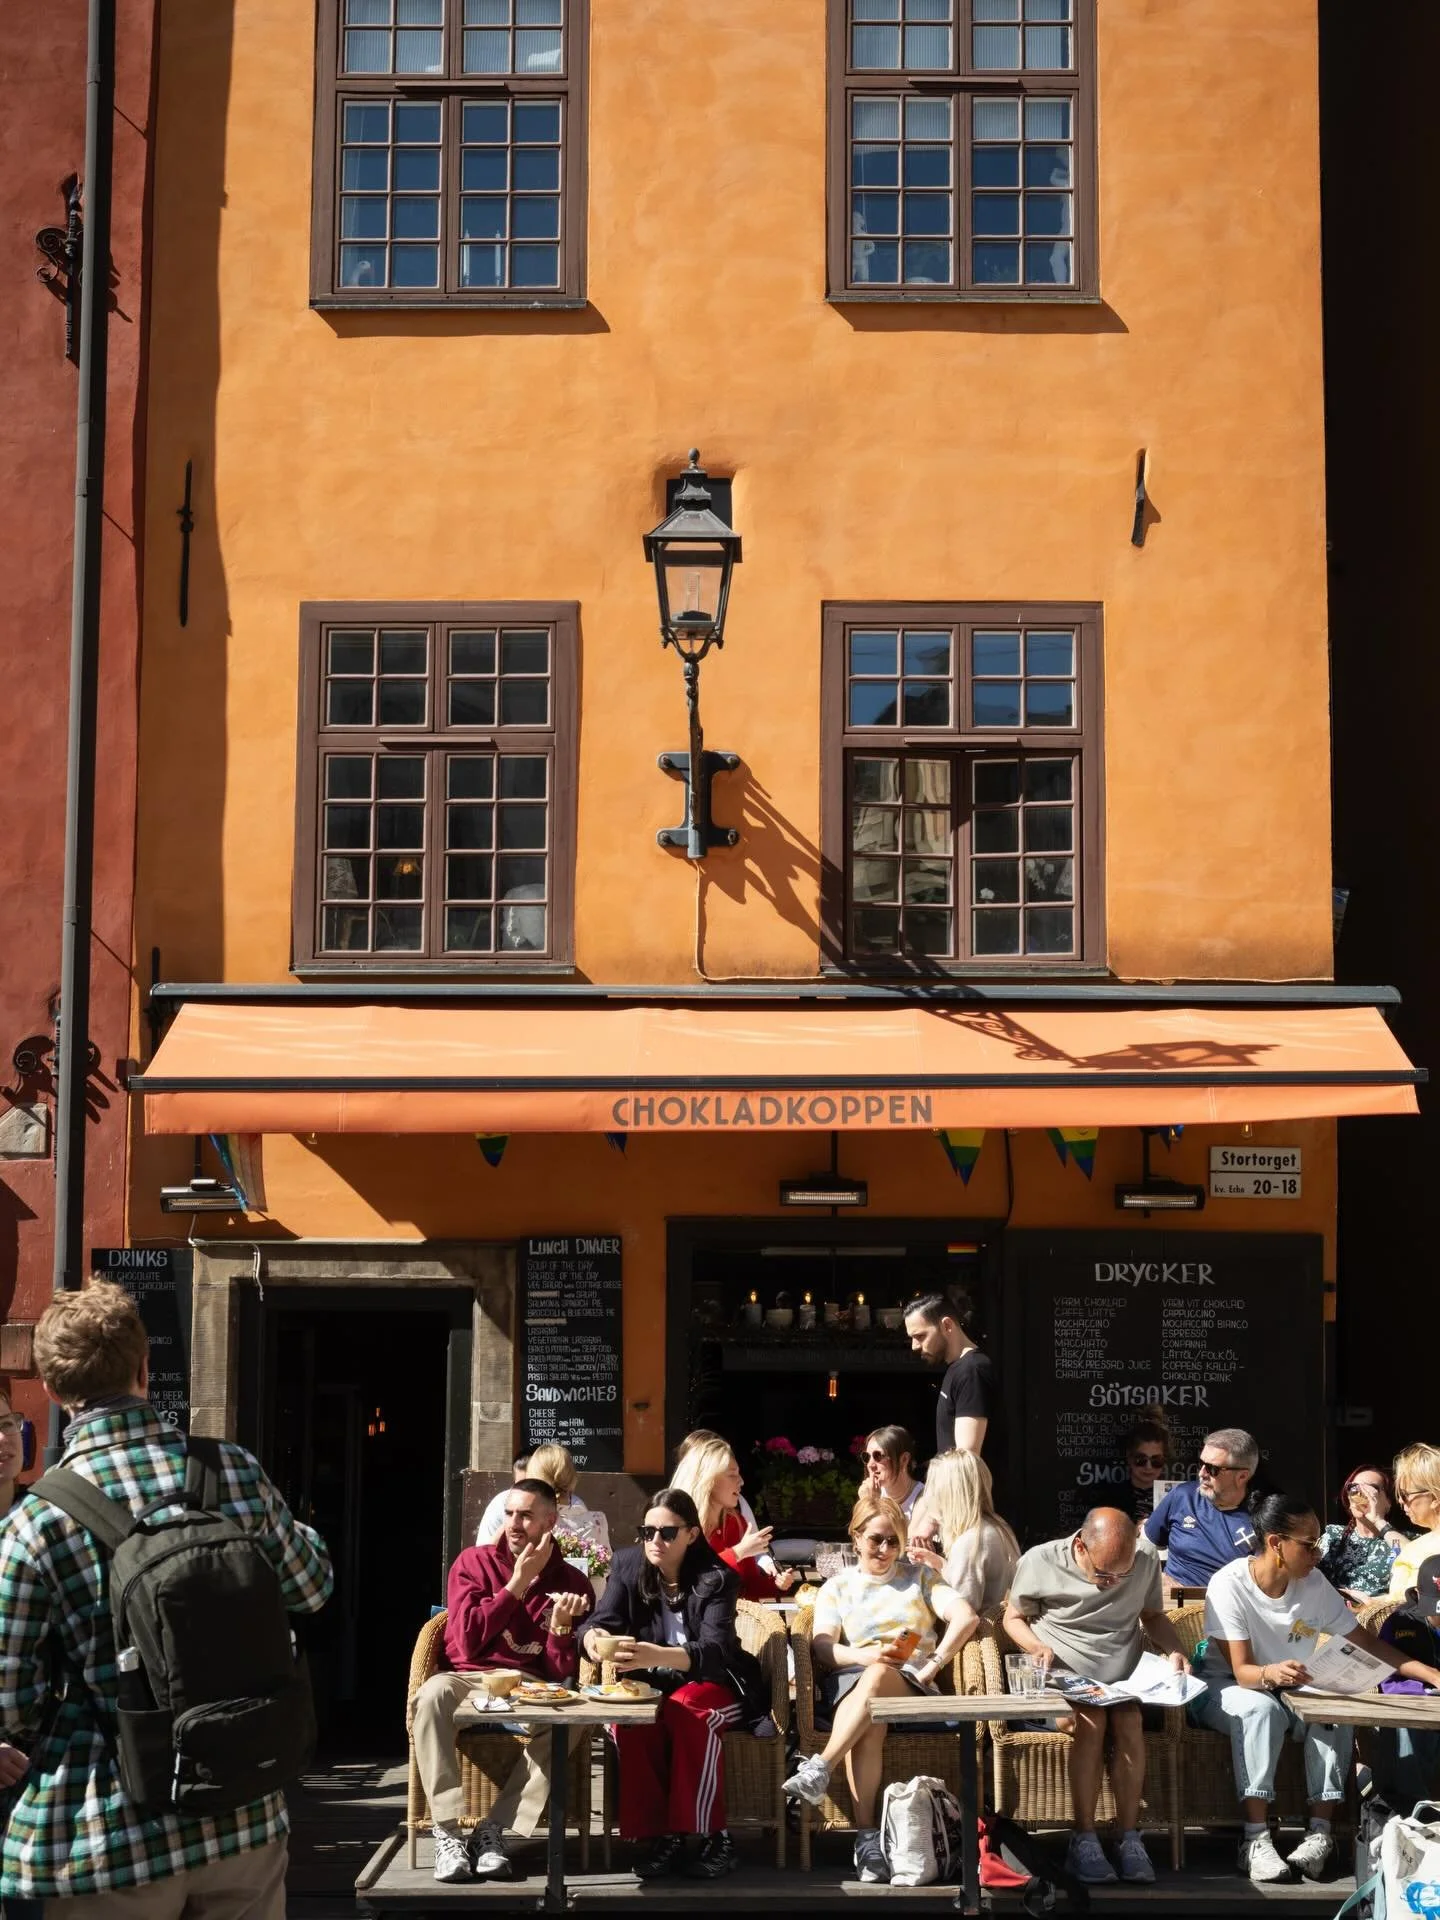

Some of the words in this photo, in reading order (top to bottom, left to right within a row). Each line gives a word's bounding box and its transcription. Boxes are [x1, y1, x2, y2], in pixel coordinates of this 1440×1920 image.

[612, 1095, 933, 1126] CHOKLADKOPPEN
[1222, 1151, 1297, 1170] Stortorget
[1229, 1185, 1245, 1193] Echo
[1253, 1179, 1297, 1195] 20-18
[529, 1240, 569, 1255] LUNCH
[576, 1239, 620, 1255] DINNER
[108, 1250, 168, 1268] DRINKS
[1094, 1263, 1215, 1286] DRYCKER
[1203, 1300, 1246, 1310] CHOKLAD
[1163, 1310, 1216, 1319] CAPPUCCINO
[1054, 1319, 1110, 1329] MOCHACCINO
[1162, 1320, 1214, 1329] MOCHACCINO
[1217, 1320, 1248, 1329] BIANCO
[1162, 1329, 1208, 1339] ESPRESSO
[1054, 1338, 1108, 1349] MACCHIATO
[1128, 1360, 1152, 1369] JUICE
[1161, 1371, 1201, 1382] CHOKLAD
[1203, 1372, 1233, 1384] DRINK
[525, 1383, 617, 1402] SANDWICHES
[1088, 1382, 1210, 1408] SÖTSAKER
[528, 1408, 557, 1418] CHEESE
[529, 1419, 557, 1428] CHEESE
[569, 1418, 585, 1427] HAM
[529, 1428, 556, 1437] TURKEY
[572, 1437, 587, 1446] BRIE
